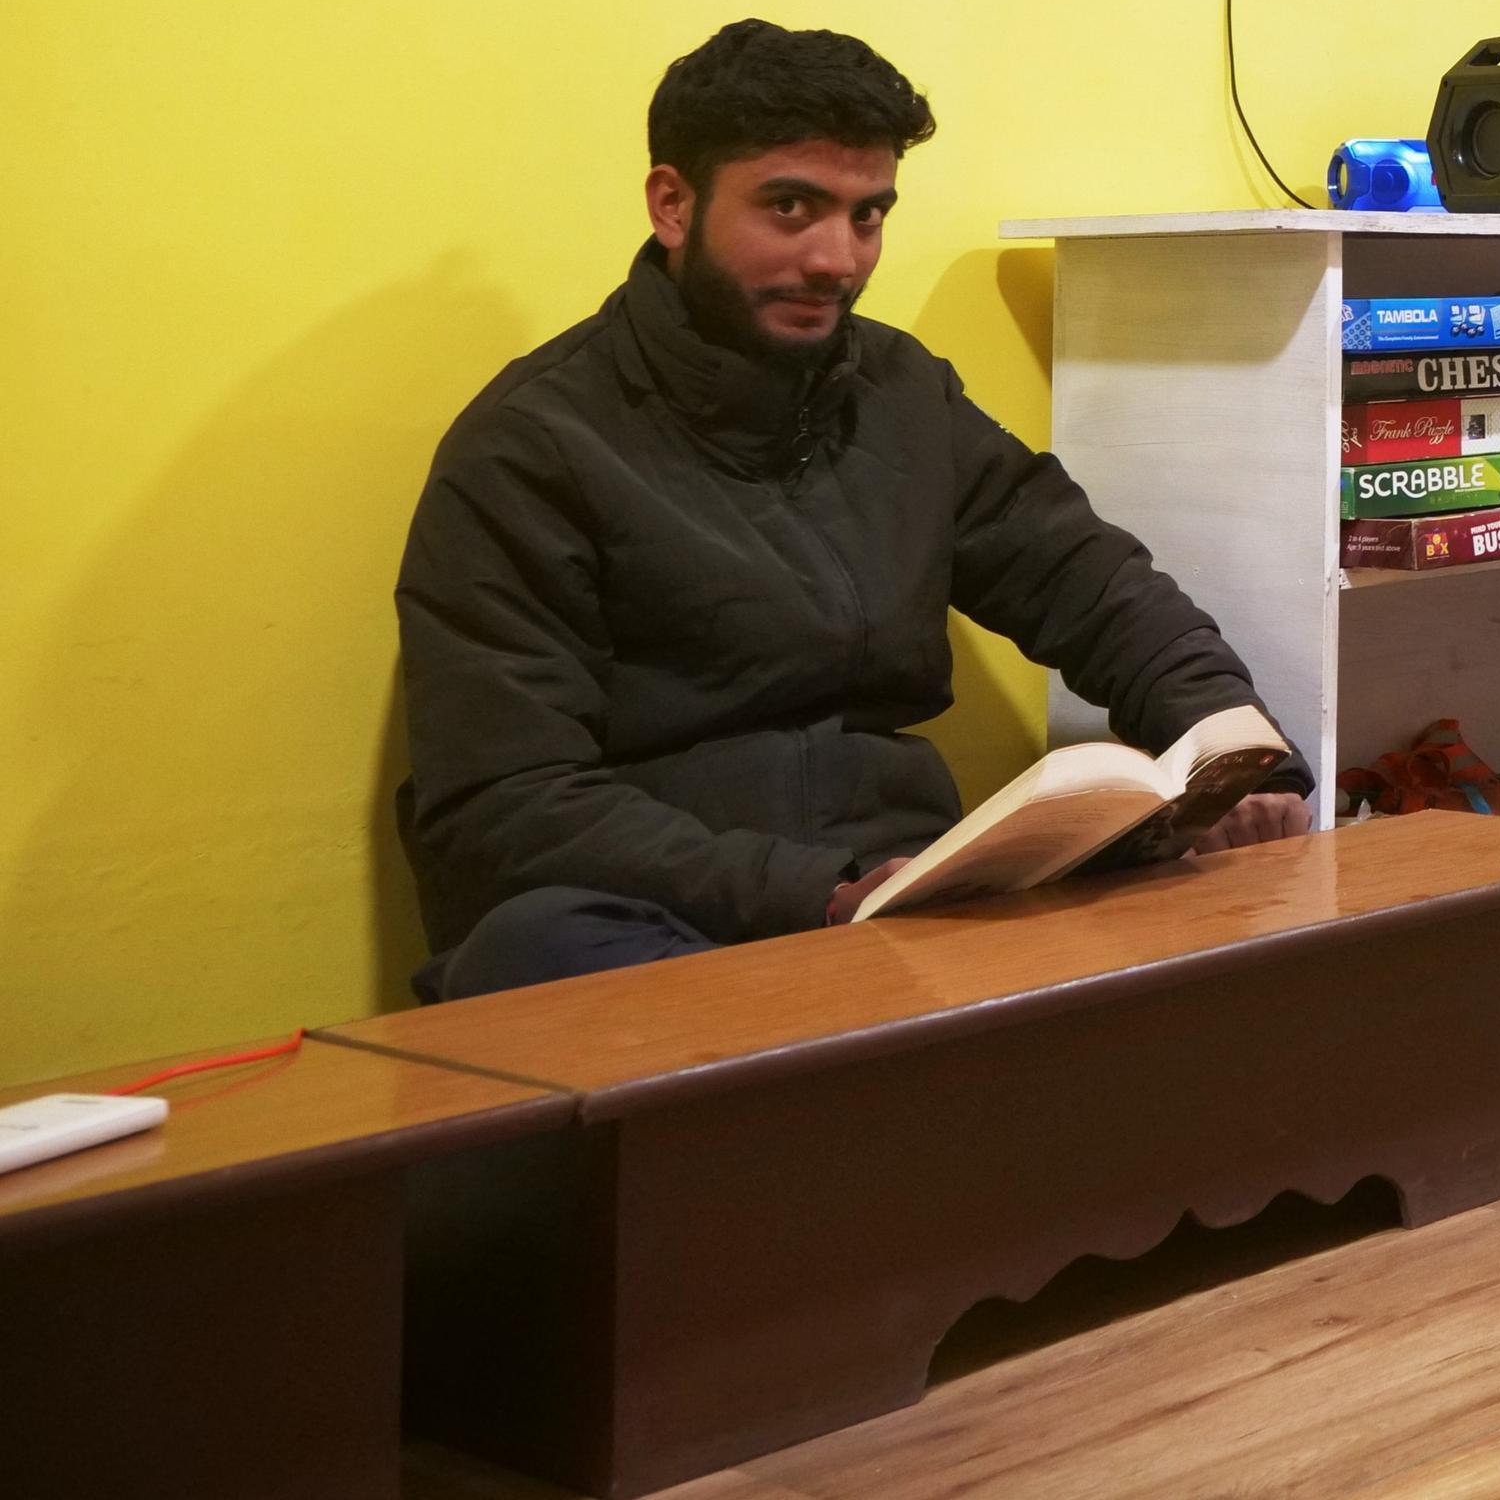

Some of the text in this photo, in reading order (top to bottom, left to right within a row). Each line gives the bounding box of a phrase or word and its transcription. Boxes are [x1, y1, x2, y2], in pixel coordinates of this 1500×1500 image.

[1377, 309, 1438, 324] TAMBOLA
[1369, 416, 1455, 445] Frank Puzzle
[1359, 463, 1486, 499] SCRABBLE
[1471, 525, 1486, 534] MIND
